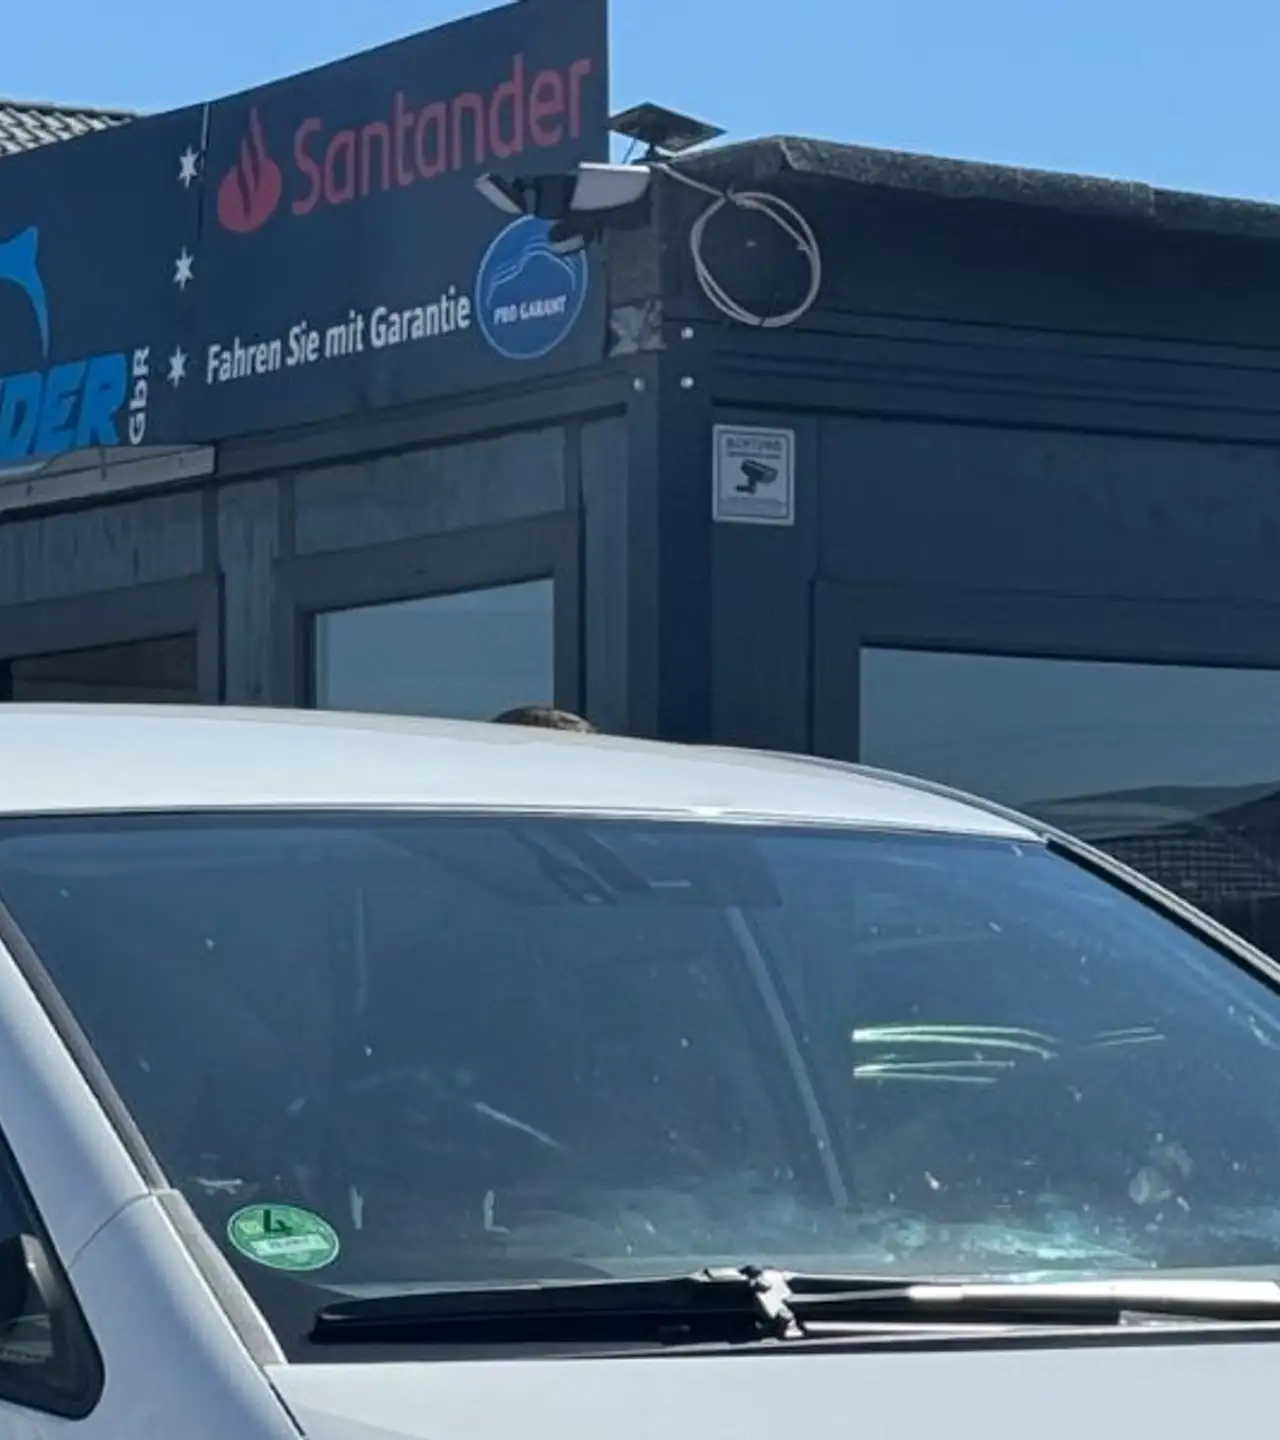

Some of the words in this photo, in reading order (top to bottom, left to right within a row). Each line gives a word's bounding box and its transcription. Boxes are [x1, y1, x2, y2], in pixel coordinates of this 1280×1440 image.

[291, 53, 592, 215] Santander
[206, 337, 281, 385] Fahren
[285, 320, 321, 366] Sie
[324, 309, 364, 360] mit
[370, 285, 472, 349] Garantie
[493, 303, 518, 326] PRO
[520, 295, 567, 321] GARANT
[129, 345, 151, 446] GbR
[263, 1209, 292, 1236] 4
